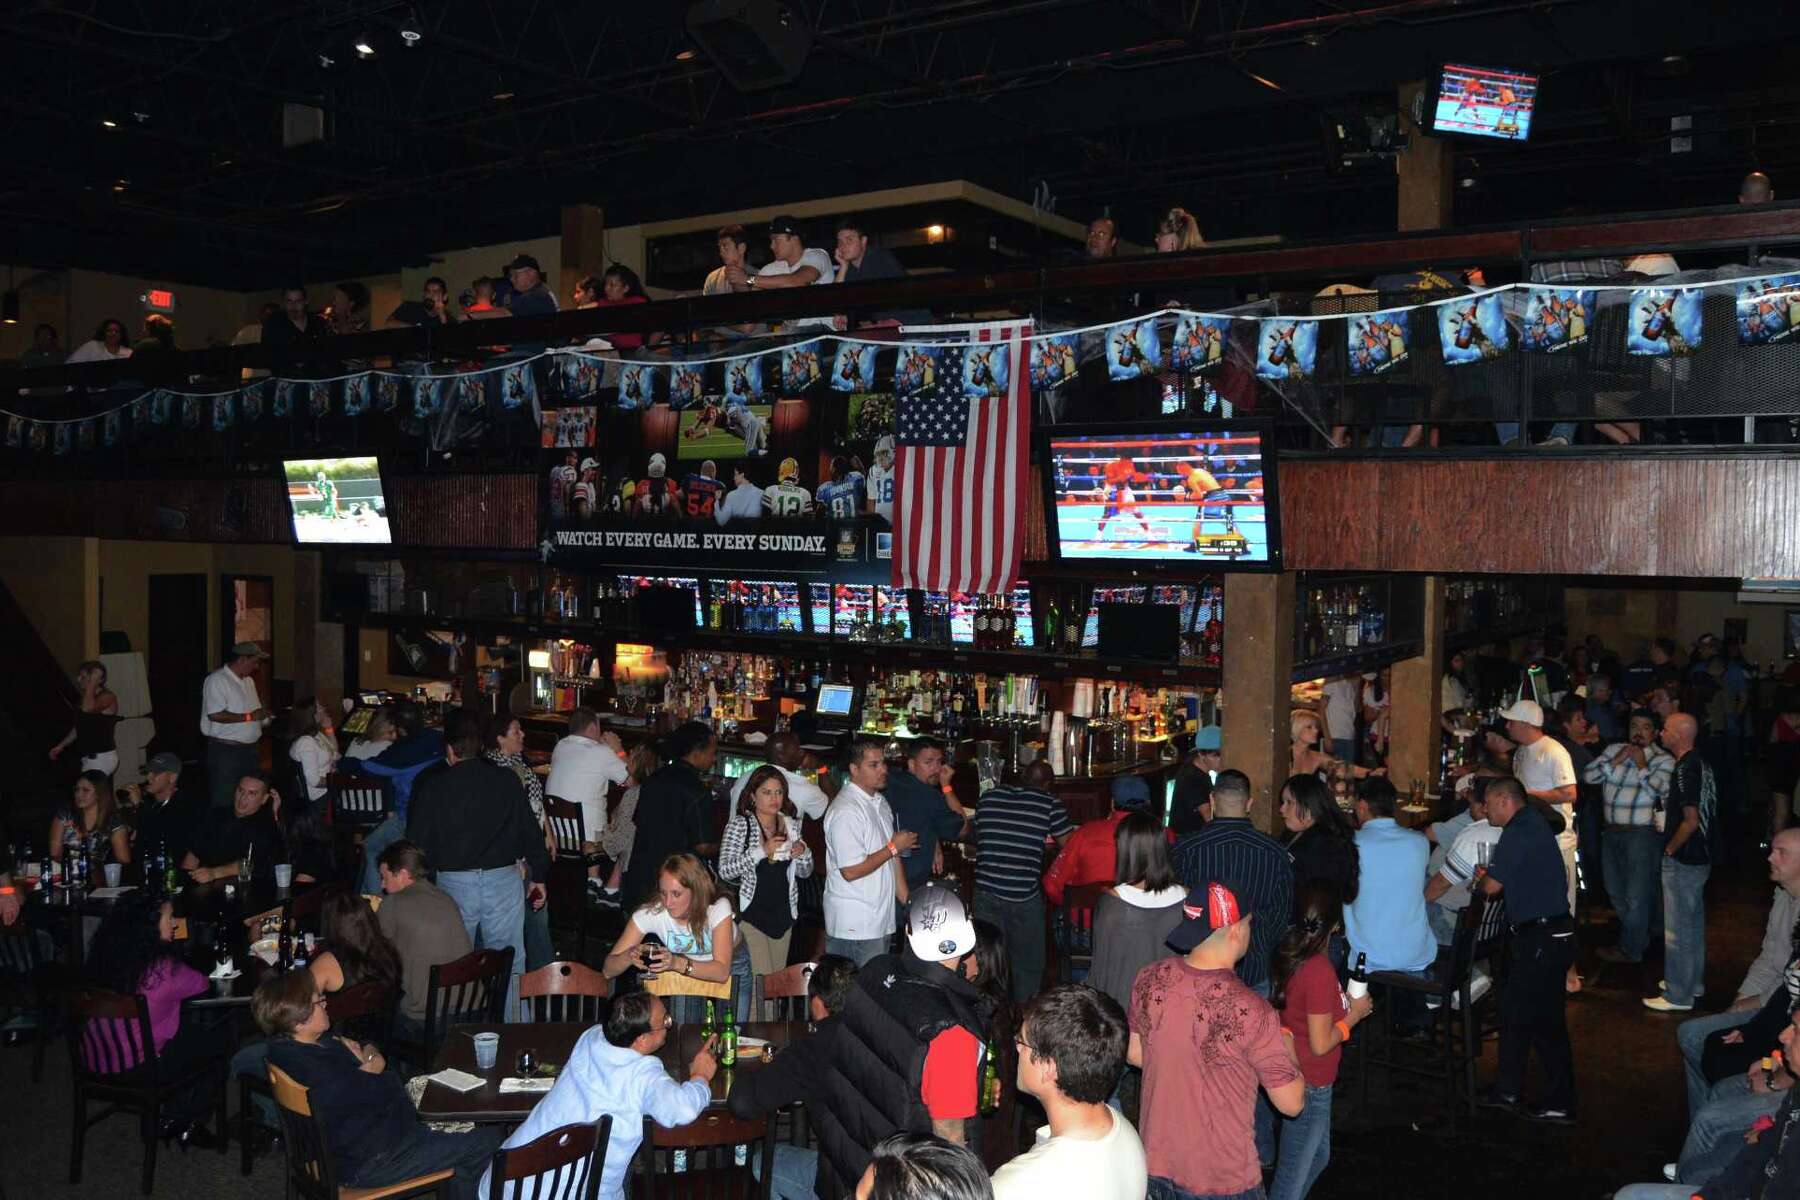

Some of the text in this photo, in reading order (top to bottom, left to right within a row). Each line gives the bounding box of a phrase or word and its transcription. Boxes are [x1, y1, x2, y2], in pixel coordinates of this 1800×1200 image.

[687, 493, 715, 518] 54
[777, 495, 801, 516] 12
[556, 531, 603, 546] WATCH
[605, 532, 652, 548] EVERY
[653, 532, 700, 549] GAME.
[703, 534, 757, 550] EVERY
[758, 534, 826, 552] SUNDAY.
